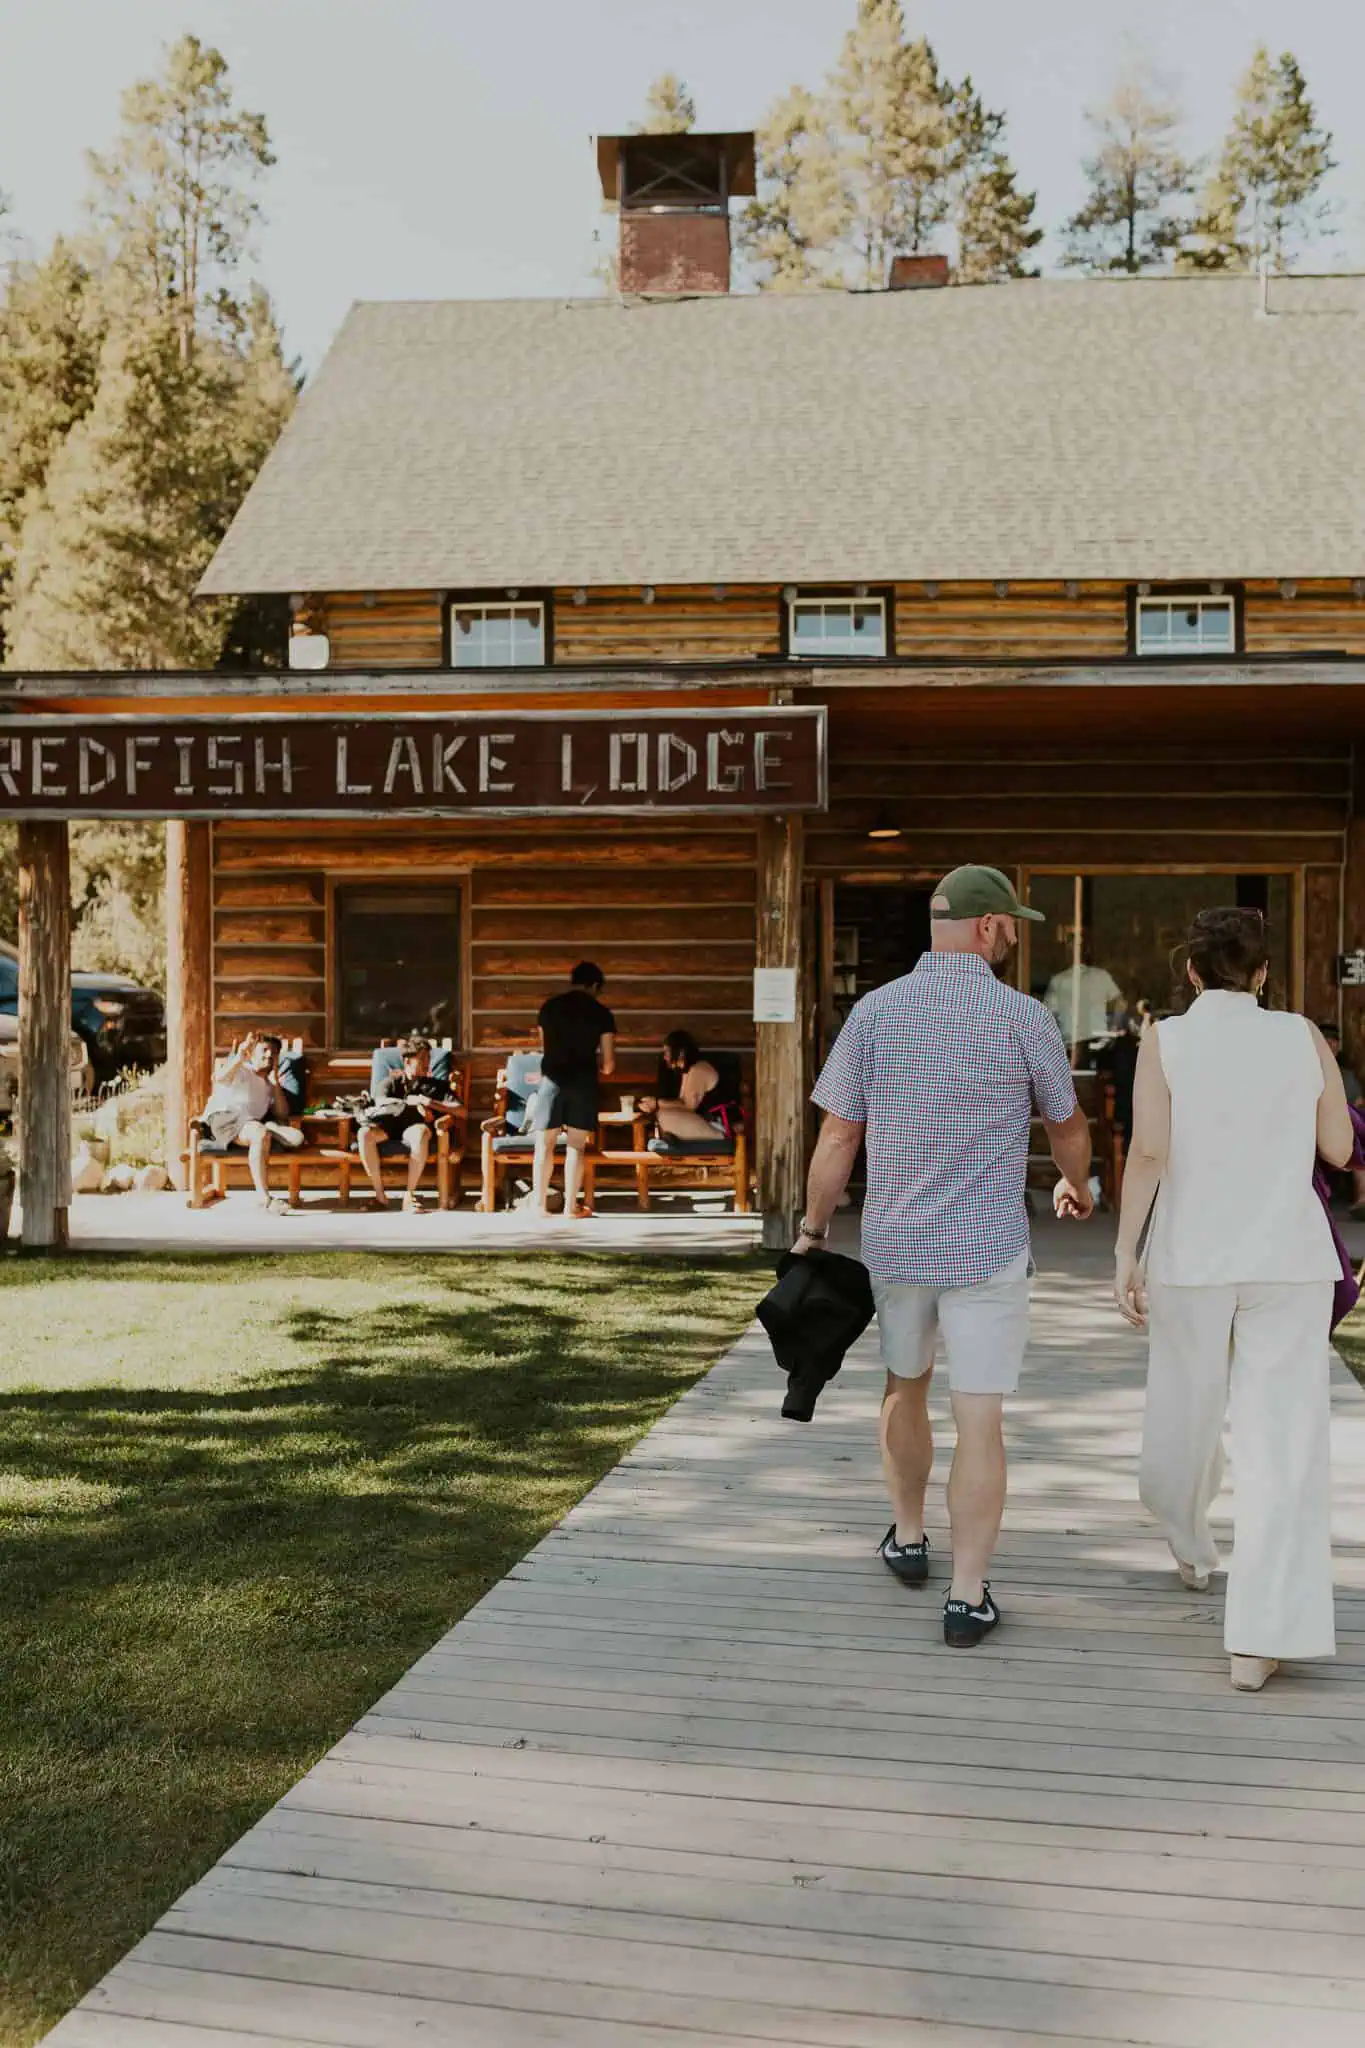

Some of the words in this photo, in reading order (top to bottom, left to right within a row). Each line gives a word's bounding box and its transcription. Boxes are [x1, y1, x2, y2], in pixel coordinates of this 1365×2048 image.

[0, 737, 292, 796] REDFISH
[336, 733, 515, 795] LAKE
[561, 729, 793, 797] LODGE
[947, 1603, 968, 1614] NIKE
